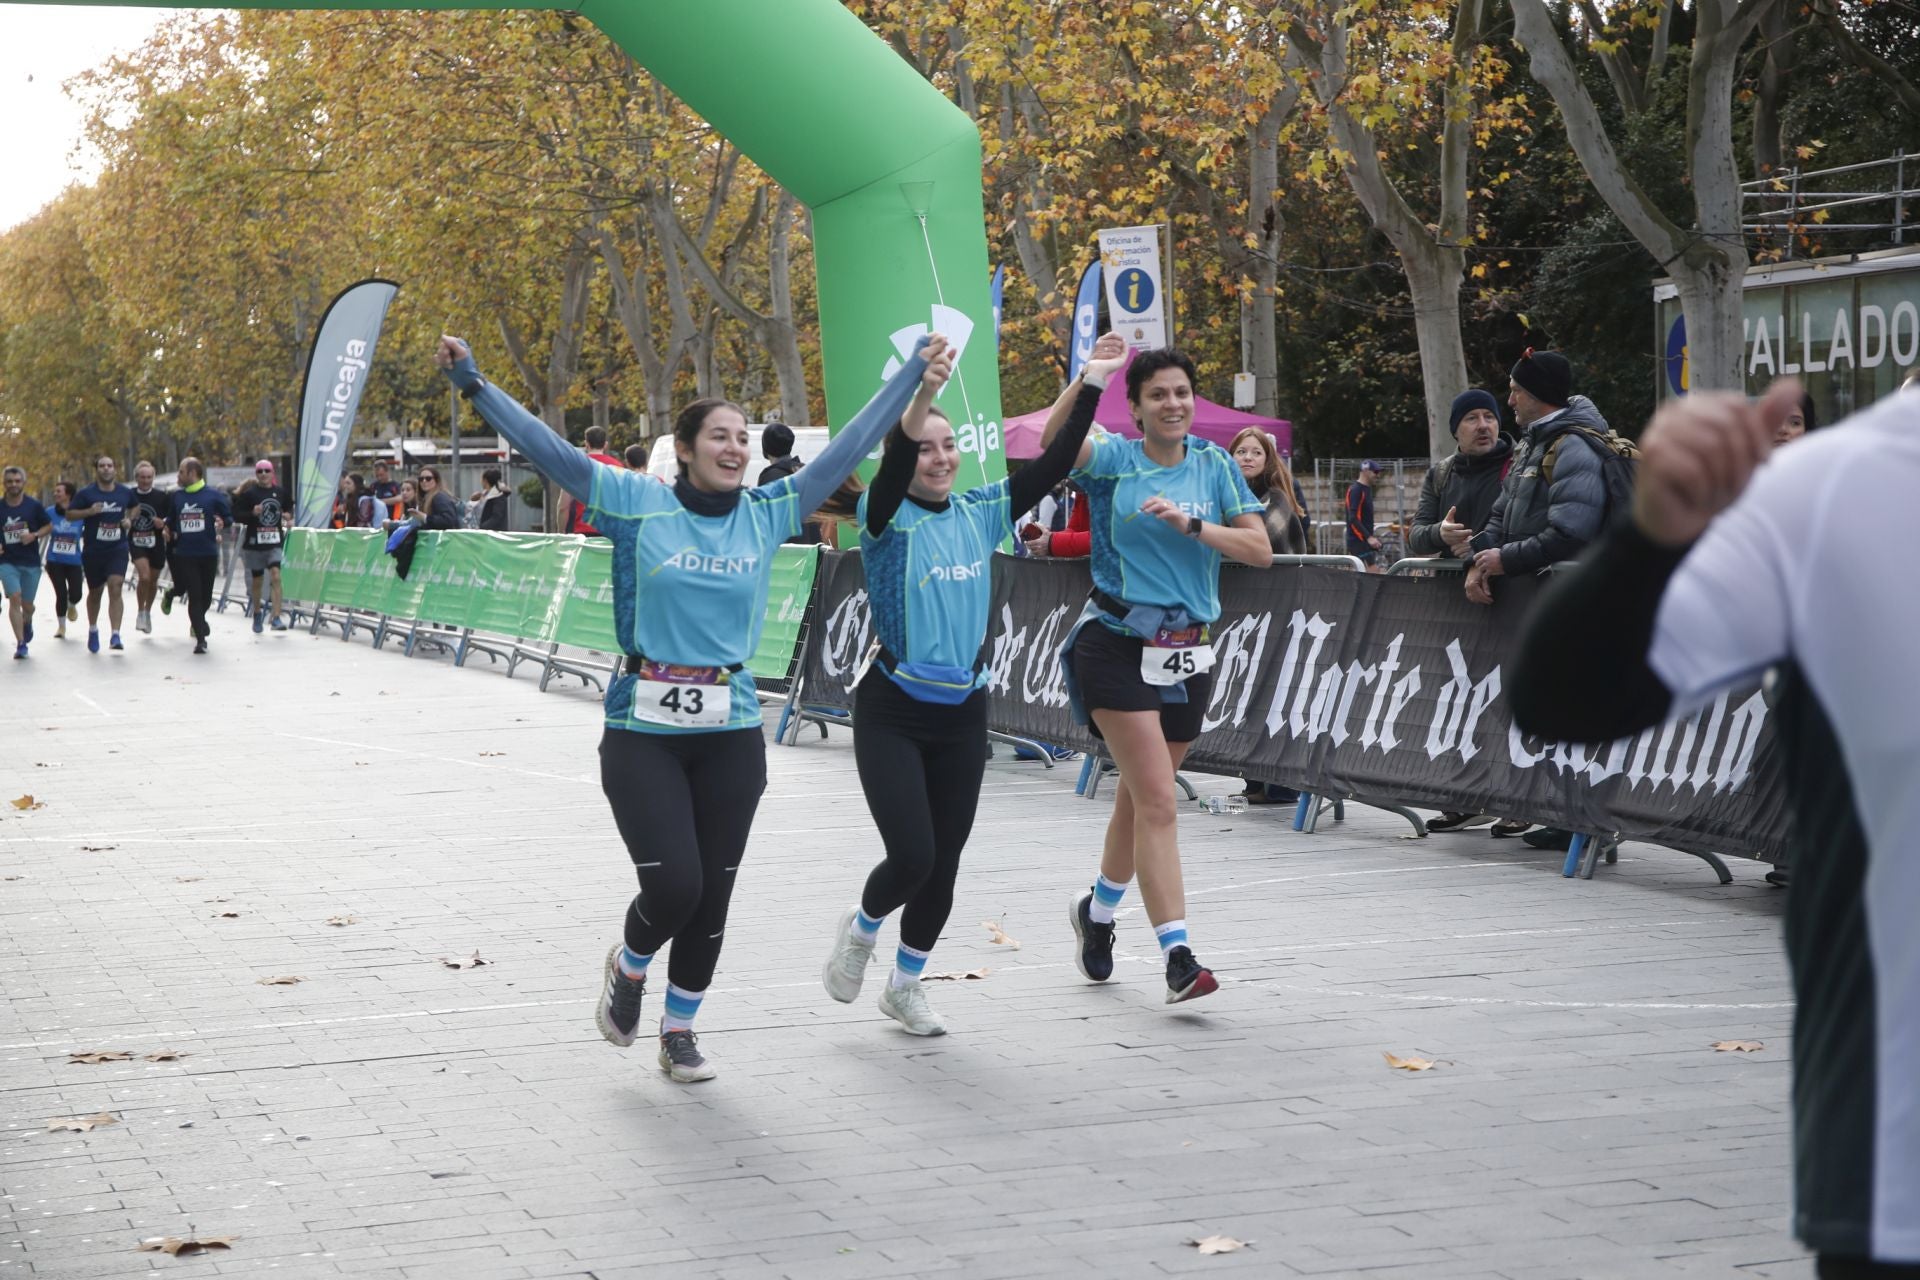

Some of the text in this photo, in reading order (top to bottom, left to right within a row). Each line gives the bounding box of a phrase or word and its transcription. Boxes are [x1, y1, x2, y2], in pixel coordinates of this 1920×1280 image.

[1744, 300, 1920, 377] ALLADO
[318, 338, 367, 453] unicaja
[183, 520, 201, 529] 708
[260, 532, 277, 541] 624
[661, 551, 758, 575] ADIENT
[1162, 650, 1196, 675] 45
[1201, 611, 1272, 732] El
[1265, 608, 1421, 756] Norte
[1423, 637, 1502, 765] de
[659, 686, 704, 715] 43
